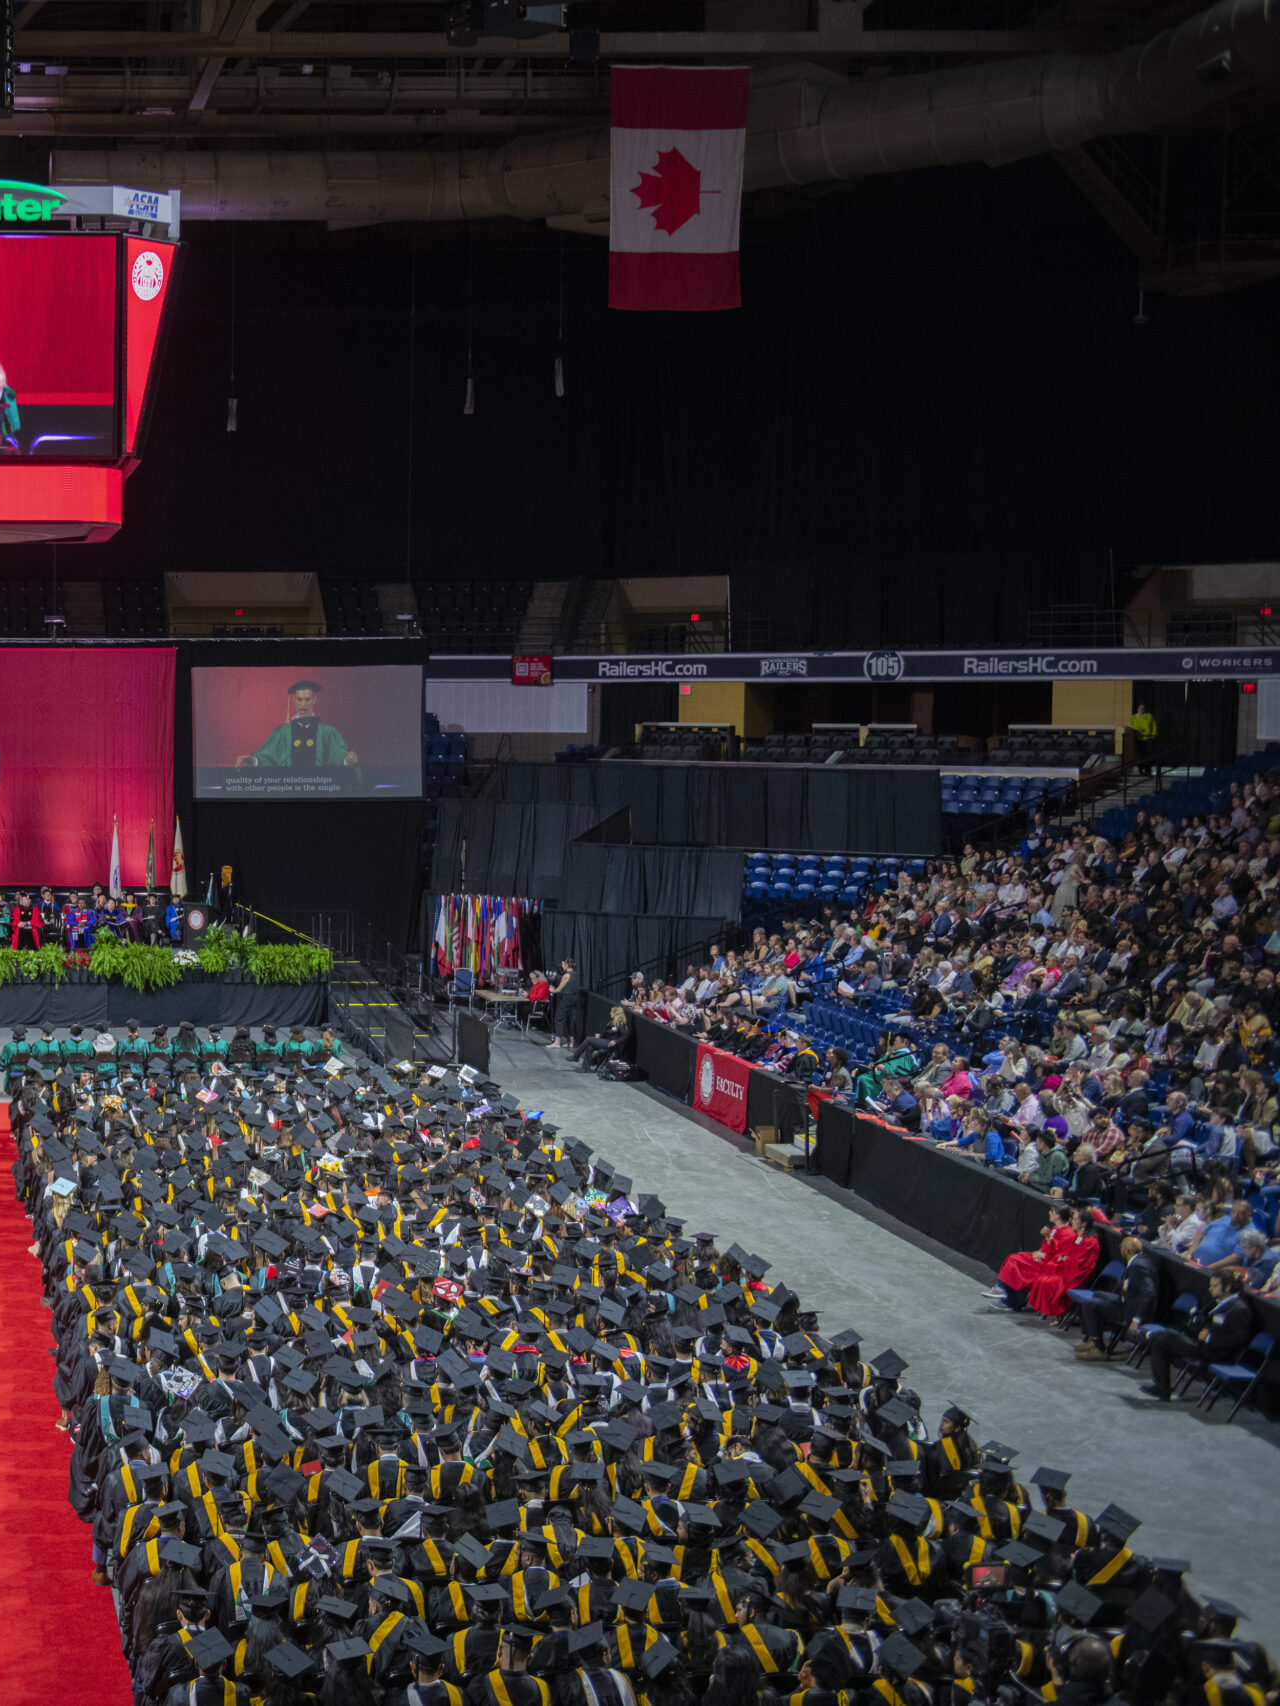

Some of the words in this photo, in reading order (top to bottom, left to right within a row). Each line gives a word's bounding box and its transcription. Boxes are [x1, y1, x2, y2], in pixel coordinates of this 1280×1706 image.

[130, 193, 159, 212] ASM
[598, 661, 707, 676] RailersHC.com
[760, 661, 807, 676] RAILERS
[869, 657, 899, 676] 105
[963, 657, 1097, 674] RailersHC.com
[1199, 658, 1273, 667] WORKERS
[264, 777, 281, 785] your
[267, 784, 293, 793] people
[317, 784, 341, 792] single
[716, 1076, 745, 1100] FACULTY
